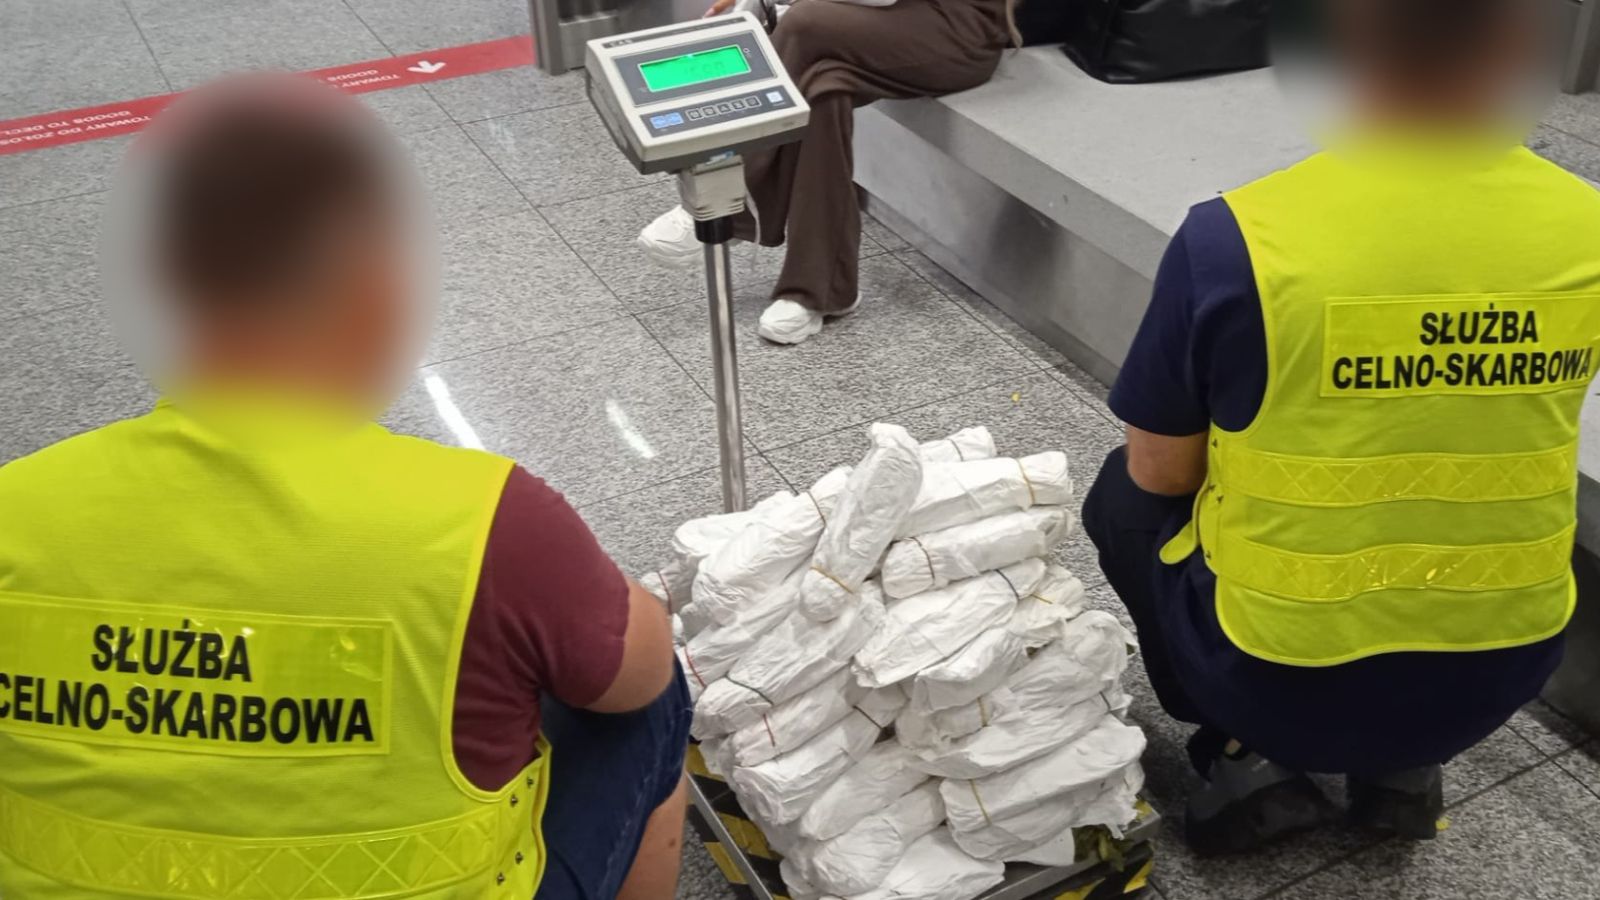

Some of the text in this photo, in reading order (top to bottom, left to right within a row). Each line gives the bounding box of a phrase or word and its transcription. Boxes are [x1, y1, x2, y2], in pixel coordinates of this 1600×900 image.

[342, 73, 400, 88] TOWARY
[73, 110, 131, 124] GOODS
[86, 115, 152, 131] TOWARY
[1420, 303, 1538, 345] SŁUŻBA
[1332, 347, 1593, 390] CELNO-SKARBOWA
[91, 618, 253, 683] SŁUŻBA
